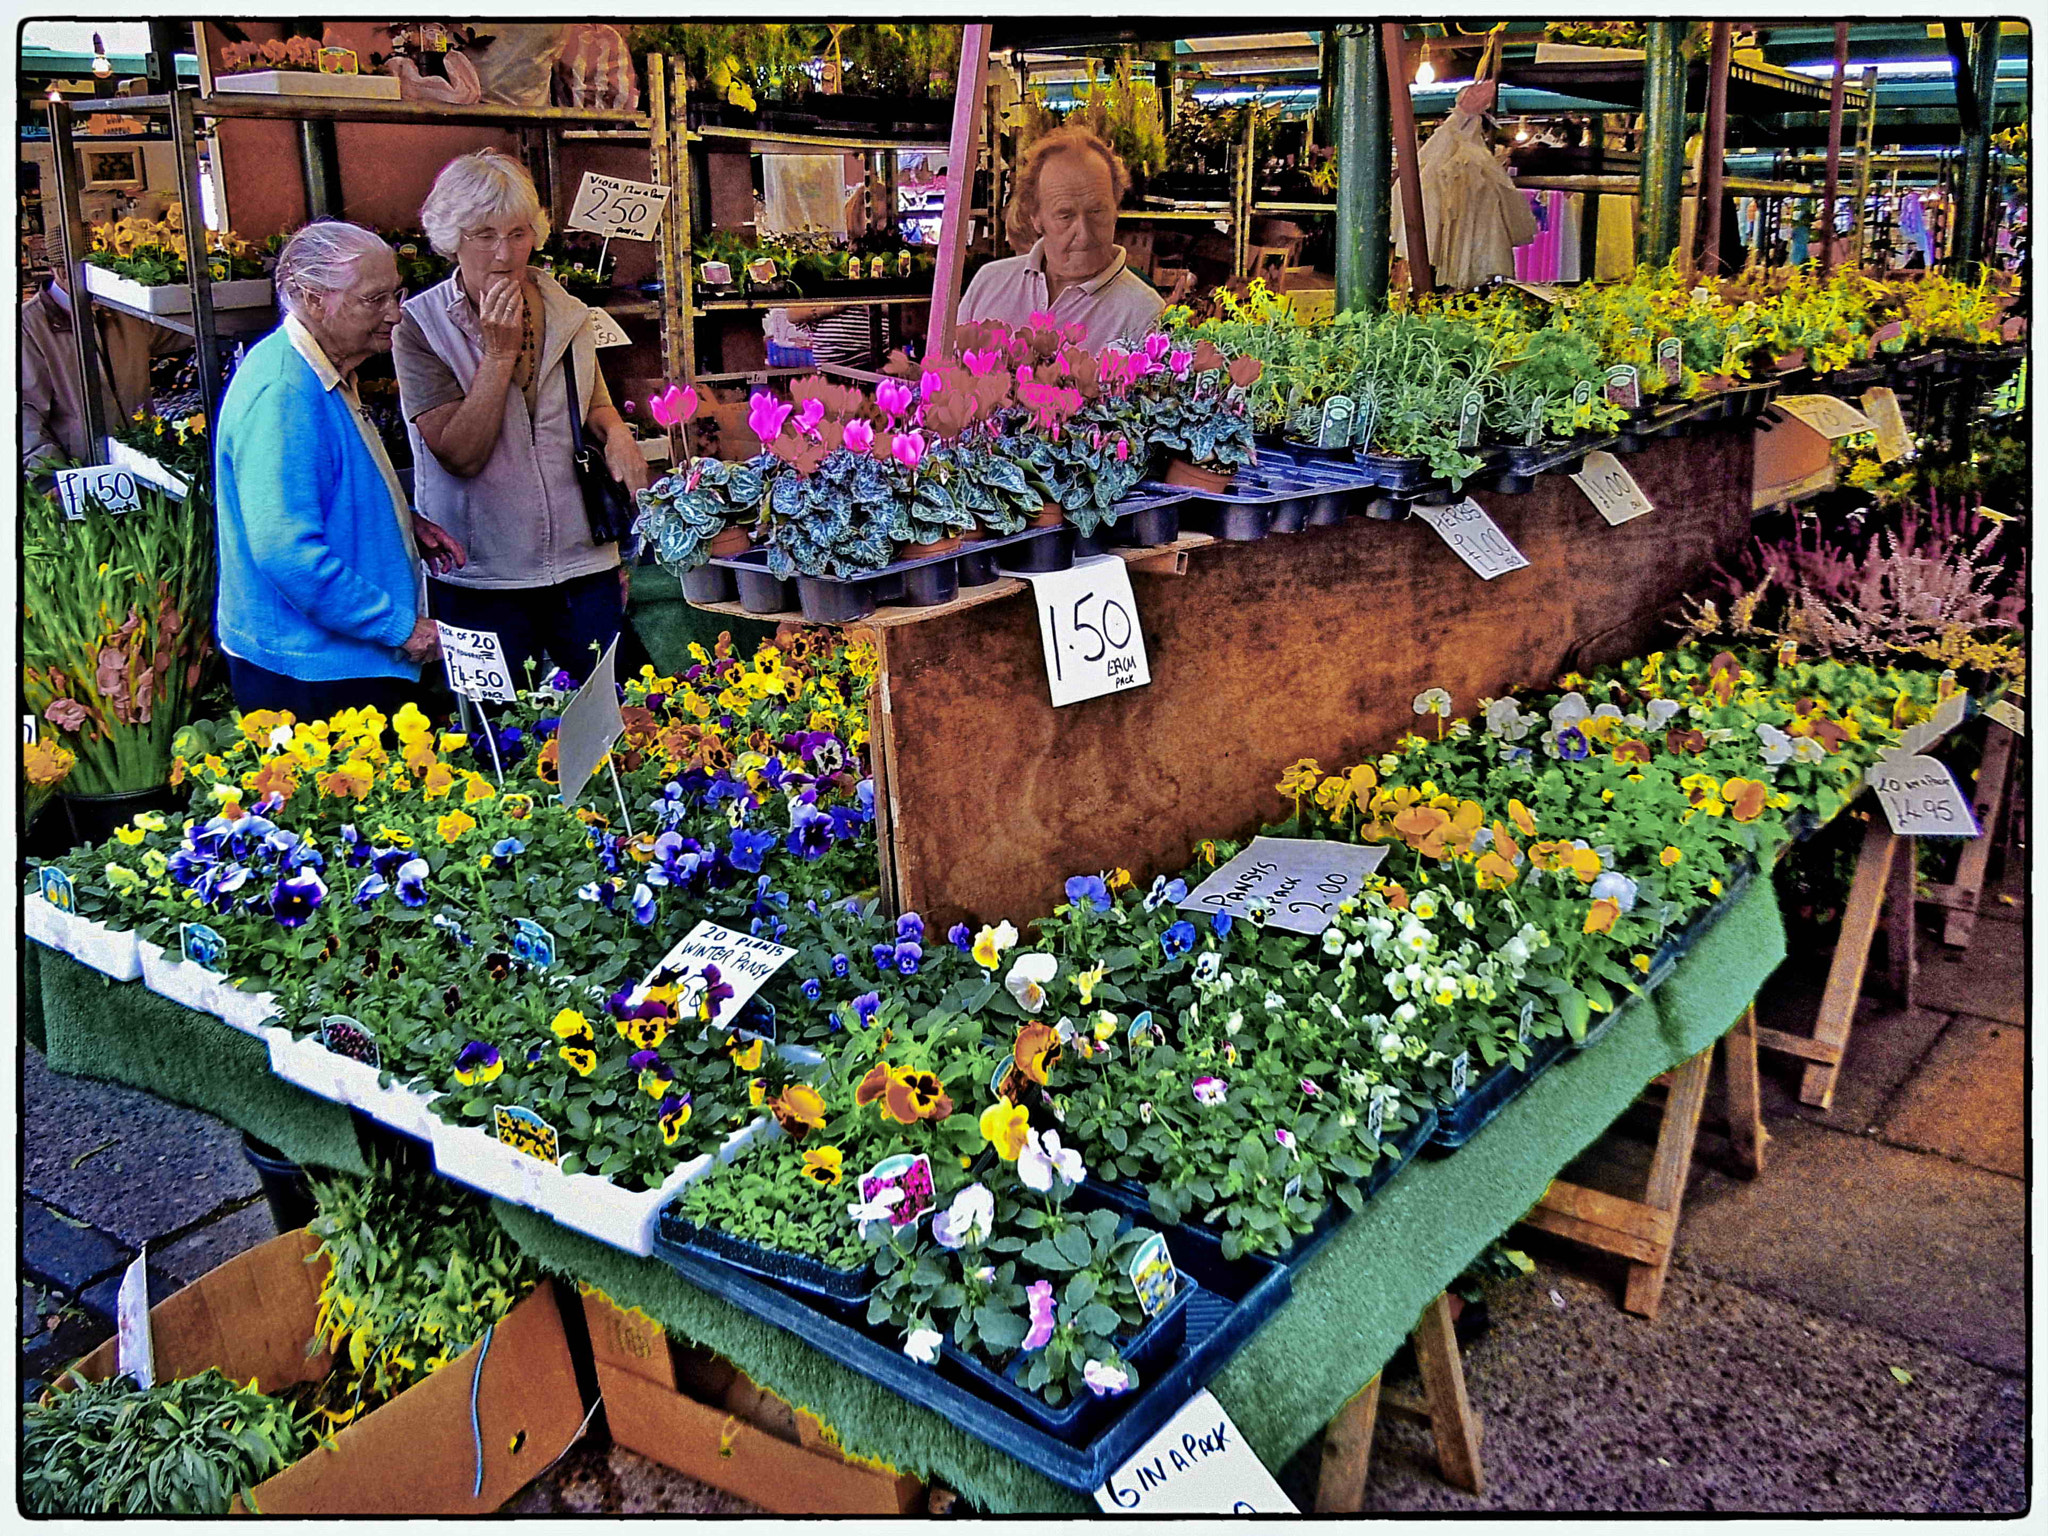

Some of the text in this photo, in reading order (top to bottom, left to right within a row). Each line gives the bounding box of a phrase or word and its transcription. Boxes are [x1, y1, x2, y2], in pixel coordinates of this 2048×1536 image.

[590, 176, 619, 190] VIOLA
[1430, 503, 1482, 533] HERBS
[1454, 527, 1510, 572] £1.00
[471, 633, 495, 650] 20
[1050, 592, 1131, 681] 1.50
[1108, 656, 1137, 676] EACH
[1115, 675, 1134, 688] PACK
[1202, 862, 1278, 907] PANSYS
[1266, 876, 1301, 904] PACK
[1288, 873, 1348, 914] 2.00
[700, 926, 784, 957] 20 PLANTS
[681, 942, 774, 980] WINTER PANSY
[1136, 1457, 1167, 1491] IN
[1169, 1449, 1190, 1471] A
